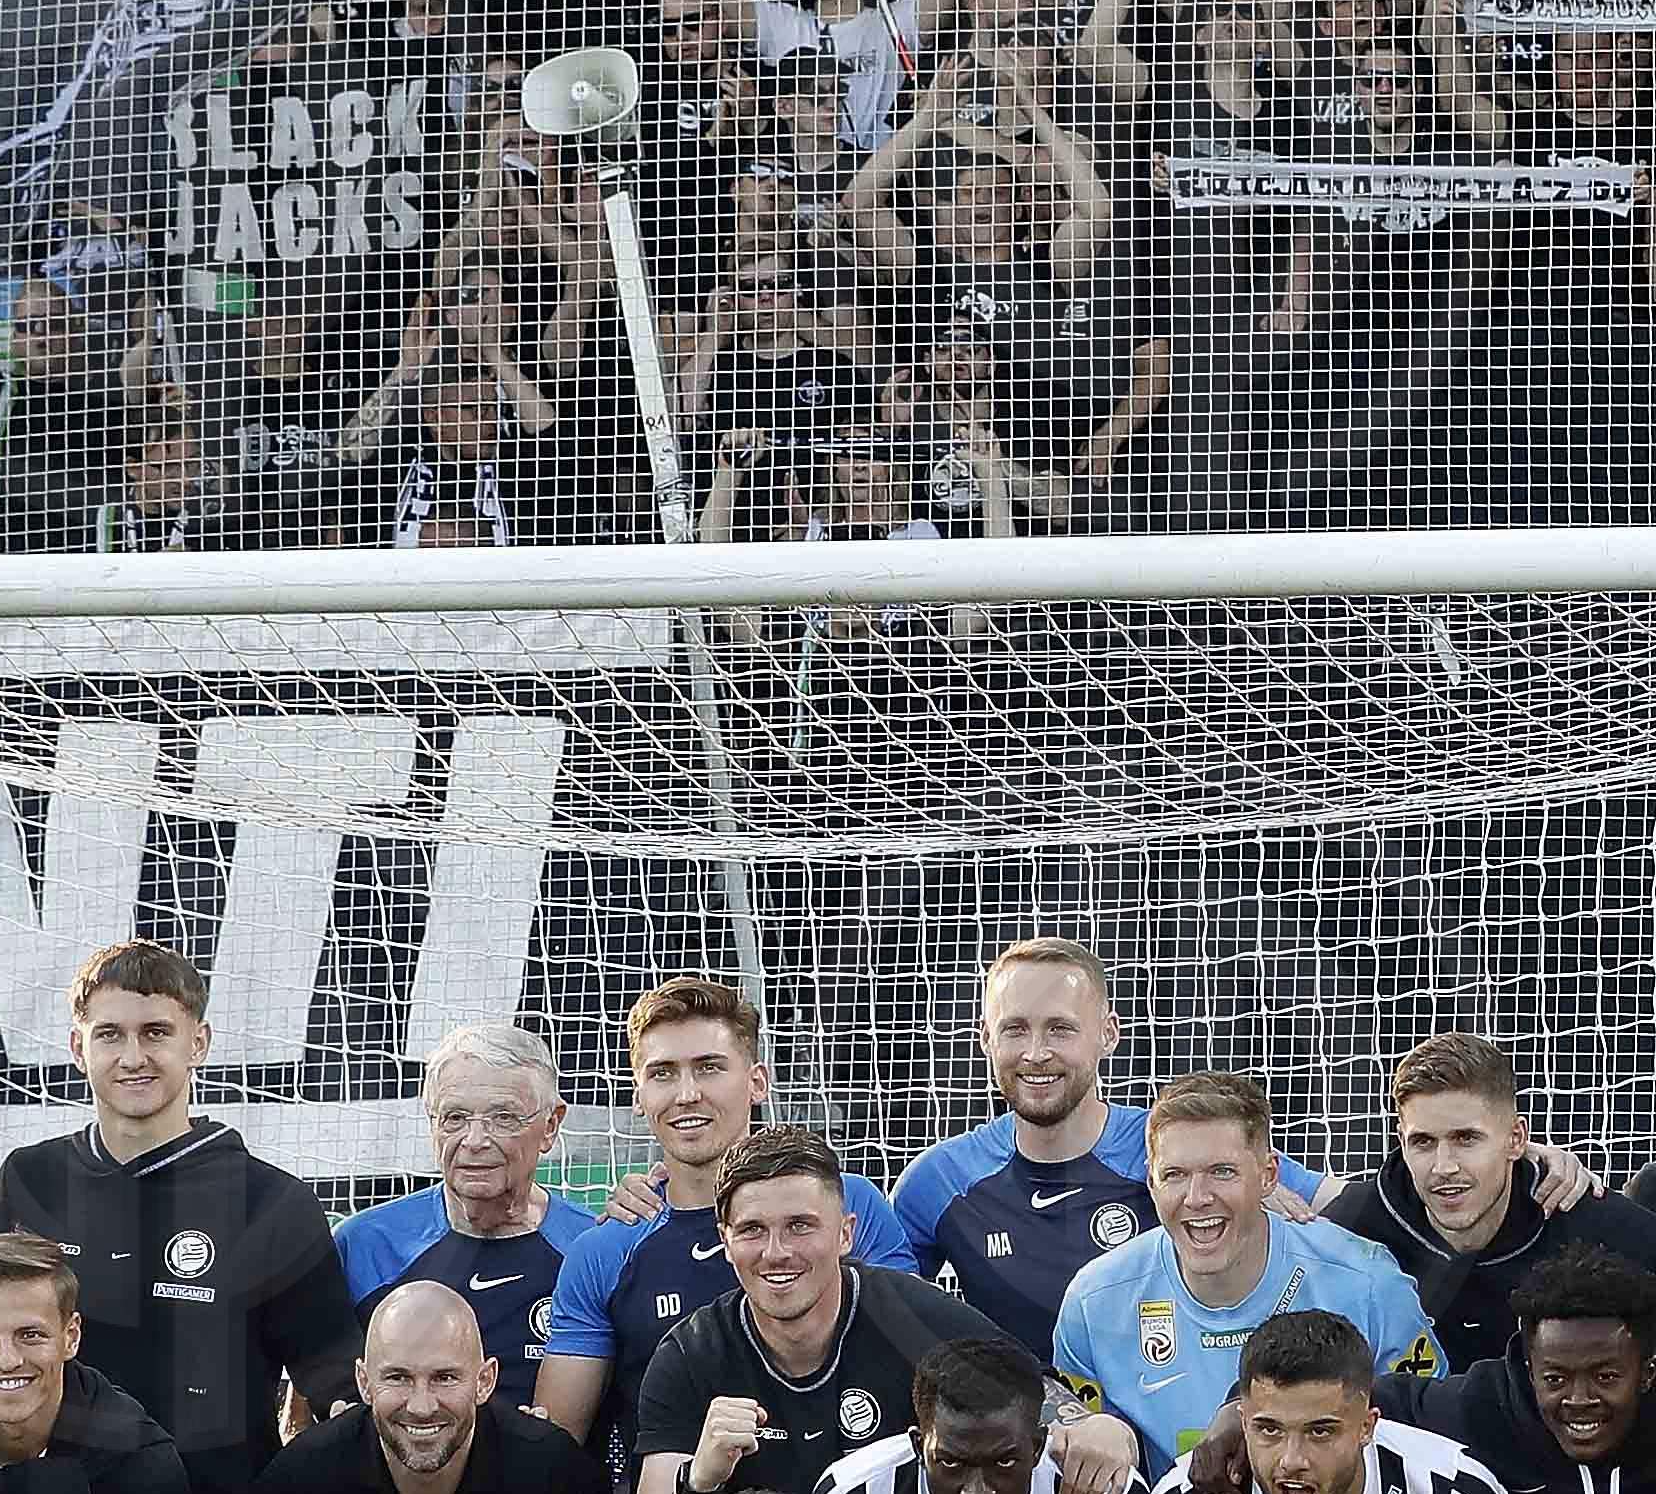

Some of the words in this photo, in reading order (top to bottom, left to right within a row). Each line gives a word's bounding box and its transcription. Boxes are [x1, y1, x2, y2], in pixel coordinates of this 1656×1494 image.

[986, 1232, 1013, 1258] MA
[156, 1283, 212, 1300] PUNTIGAMER
[655, 1293, 683, 1319] DD
